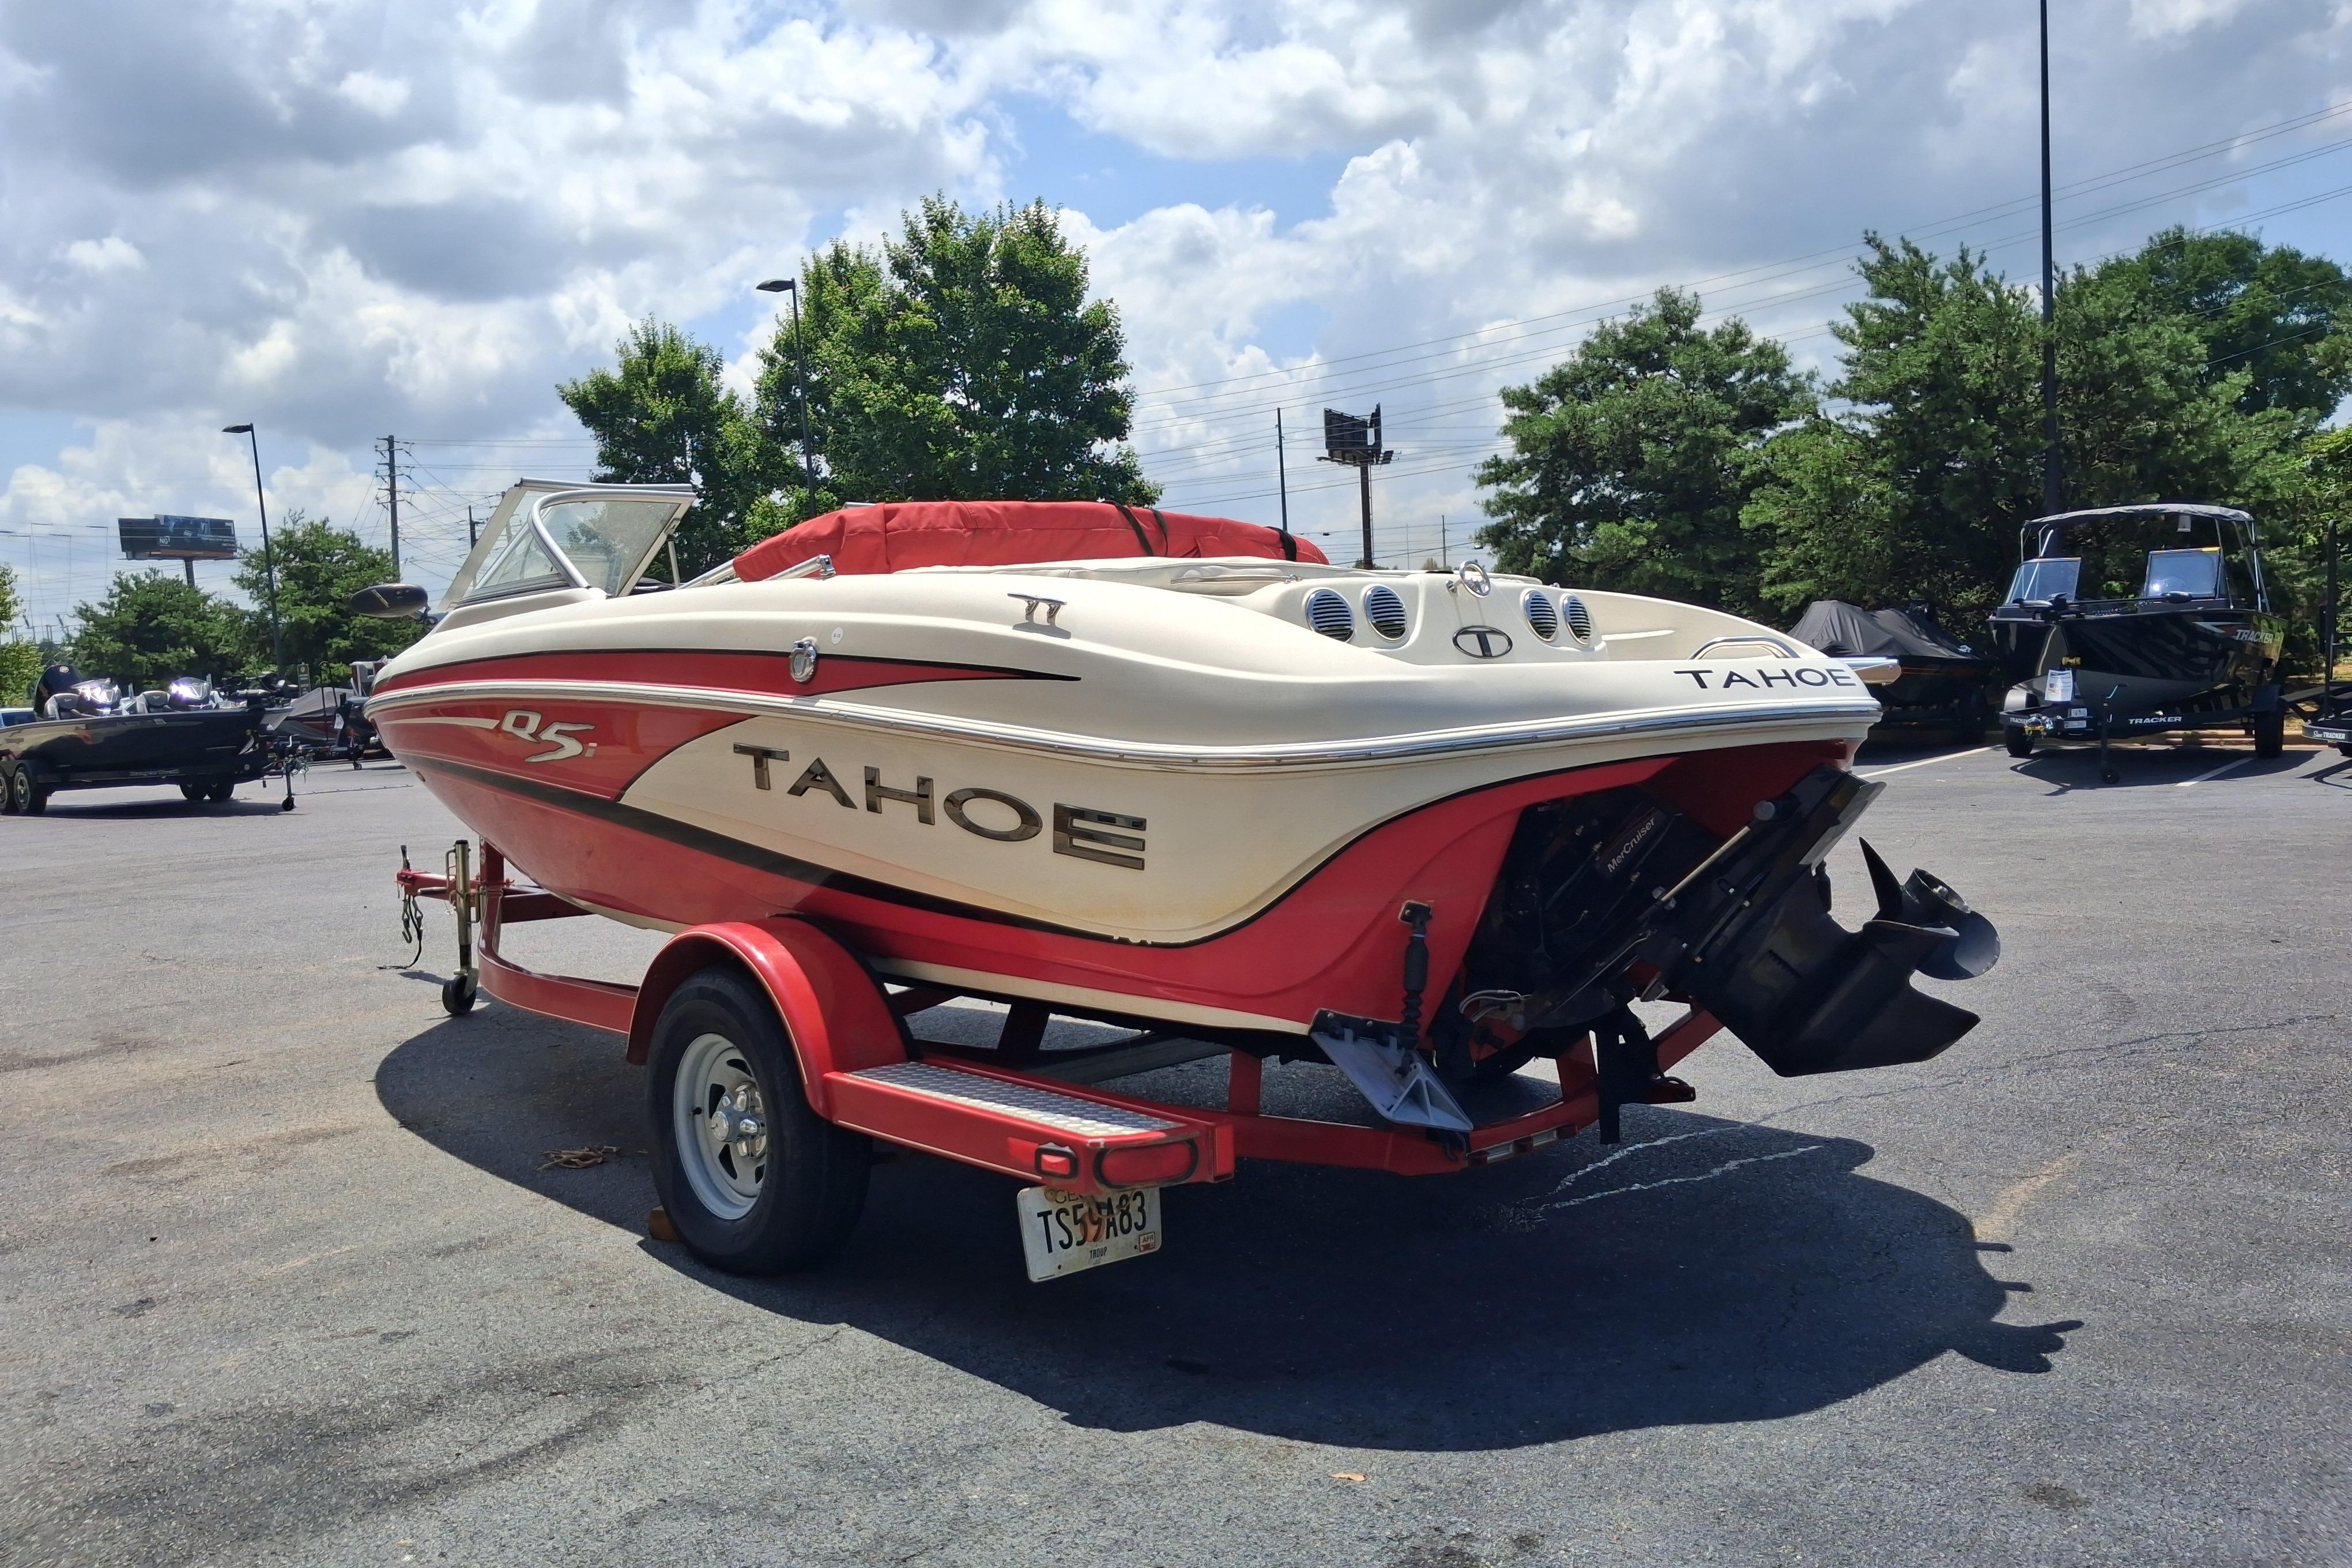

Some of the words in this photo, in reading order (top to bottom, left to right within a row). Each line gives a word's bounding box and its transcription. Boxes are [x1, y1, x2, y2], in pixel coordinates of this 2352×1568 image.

[2236, 629, 2274, 644] TRACKER
[1673, 668, 1857, 689] TAHOE
[2128, 716, 2183, 725] TRACKER
[733, 742, 1147, 871] TAHOE
[1607, 817, 1655, 873] MerCruiser
[1037, 1188, 1147, 1254] TS59A83
[1088, 1246, 1108, 1260] TROUP
